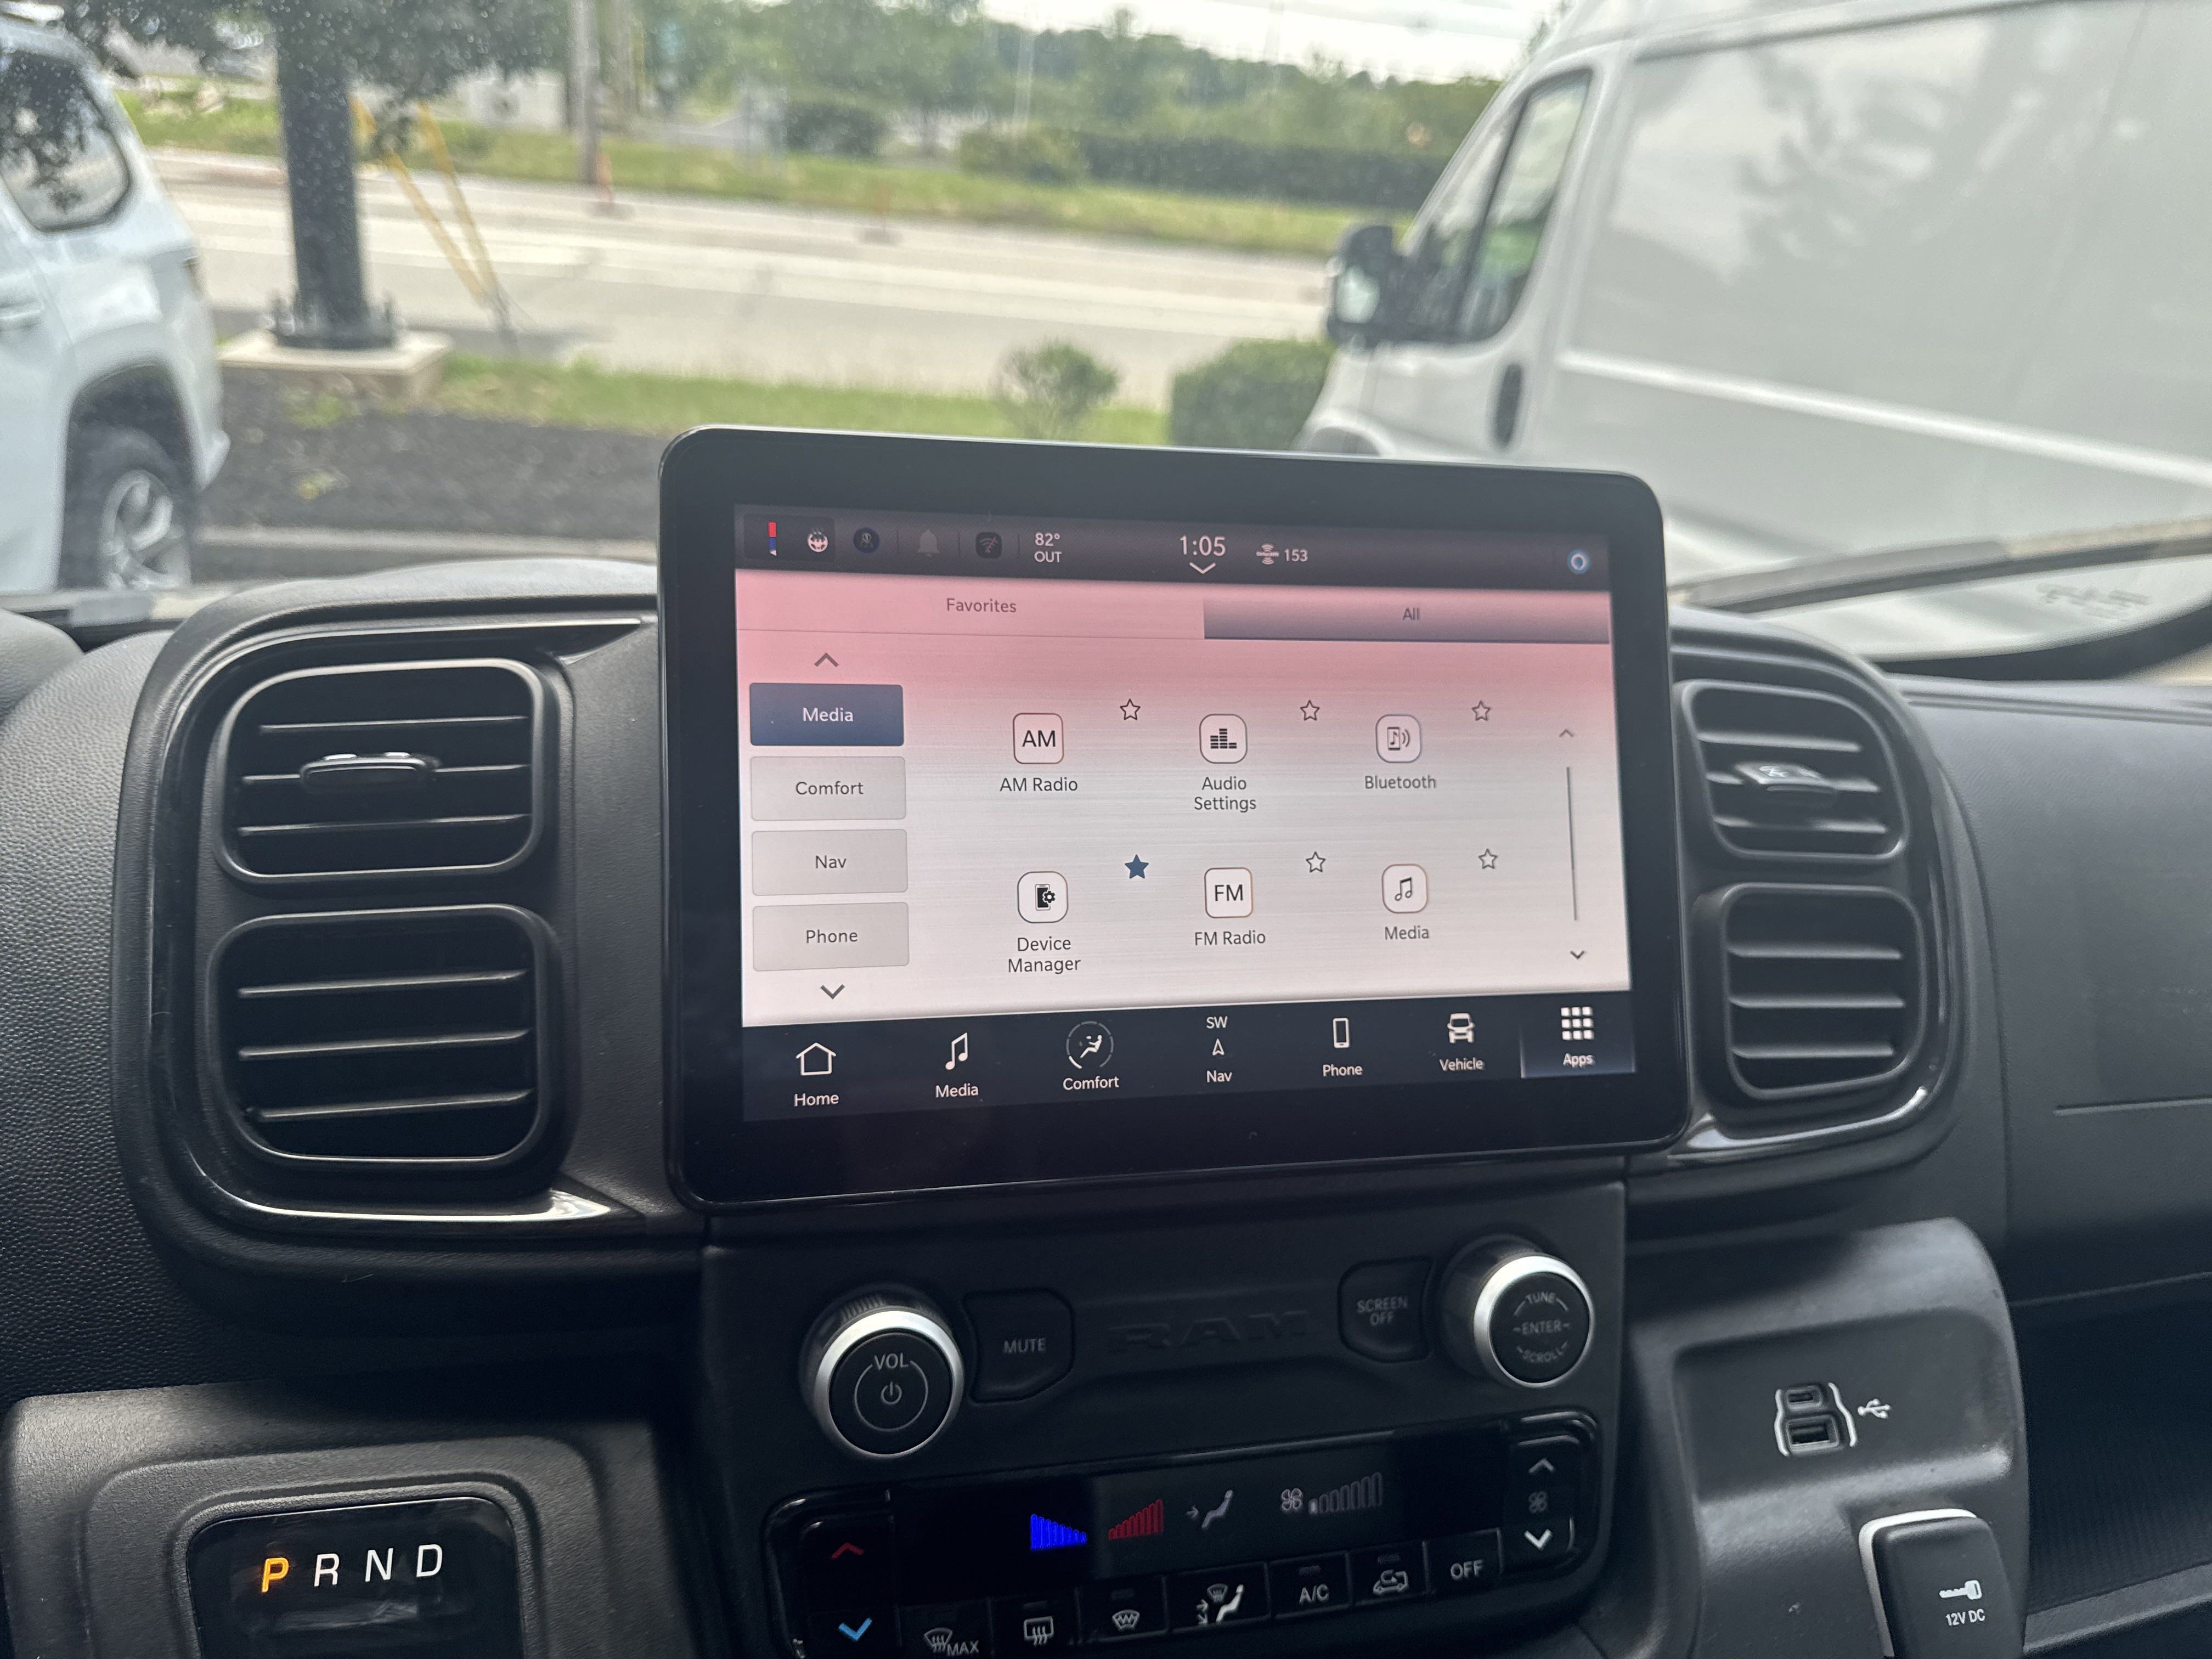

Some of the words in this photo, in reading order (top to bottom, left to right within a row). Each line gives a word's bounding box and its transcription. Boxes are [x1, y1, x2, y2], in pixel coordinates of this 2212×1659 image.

[1179, 535, 1226, 557] 1:05
[1034, 551, 1062, 563] OUT
[1284, 549, 1308, 562] 153
[946, 597, 1017, 613] Favorites
[1402, 607, 1420, 621] All
[802, 707, 854, 723] Media
[1022, 730, 1056, 748] AM
[795, 780, 864, 796] Comfort
[1000, 777, 1028, 792] AM
[1033, 776, 1078, 792] Radio
[1201, 776, 1247, 791] Audio
[1364, 775, 1437, 790] Bluetooth
[1193, 795, 1257, 813] Settings
[815, 854, 847, 870] Nav
[1214, 884, 1244, 902] FM
[805, 928, 858, 944] Phone
[1194, 931, 1217, 946] FM
[1223, 929, 1266, 946] Radio
[1384, 926, 1430, 941] Media
[1017, 936, 1071, 952] Device
[1007, 956, 1081, 976] Manager
[1206, 1015, 1228, 1029] SW
[1439, 1057, 1485, 1071] Vehicle
[1563, 1052, 1594, 1068] Apps
[1206, 1069, 1233, 1083] Nav
[1322, 1062, 1363, 1077] Phone
[935, 1083, 979, 1098] Media
[1062, 1075, 1120, 1091] Comfort
[794, 1092, 839, 1107] Home
[1356, 1296, 1409, 1313] SCREEN
[1525, 1291, 1556, 1304] TUNE
[1369, 1311, 1394, 1327] OFF
[1003, 1338, 1046, 1355] MUTE
[873, 1352, 909, 1370] VOL
[262, 1558, 290, 1593] P
[313, 1553, 340, 1587] R
[364, 1548, 394, 1582] N
[416, 1544, 443, 1578] D
[1450, 1559, 1485, 1581] OFF
[1298, 1584, 1330, 1605] A/C
[1945, 1611, 1966, 1626] 12V
[1968, 1609, 1985, 1623] DC
[946, 1639, 979, 1656] MAX
